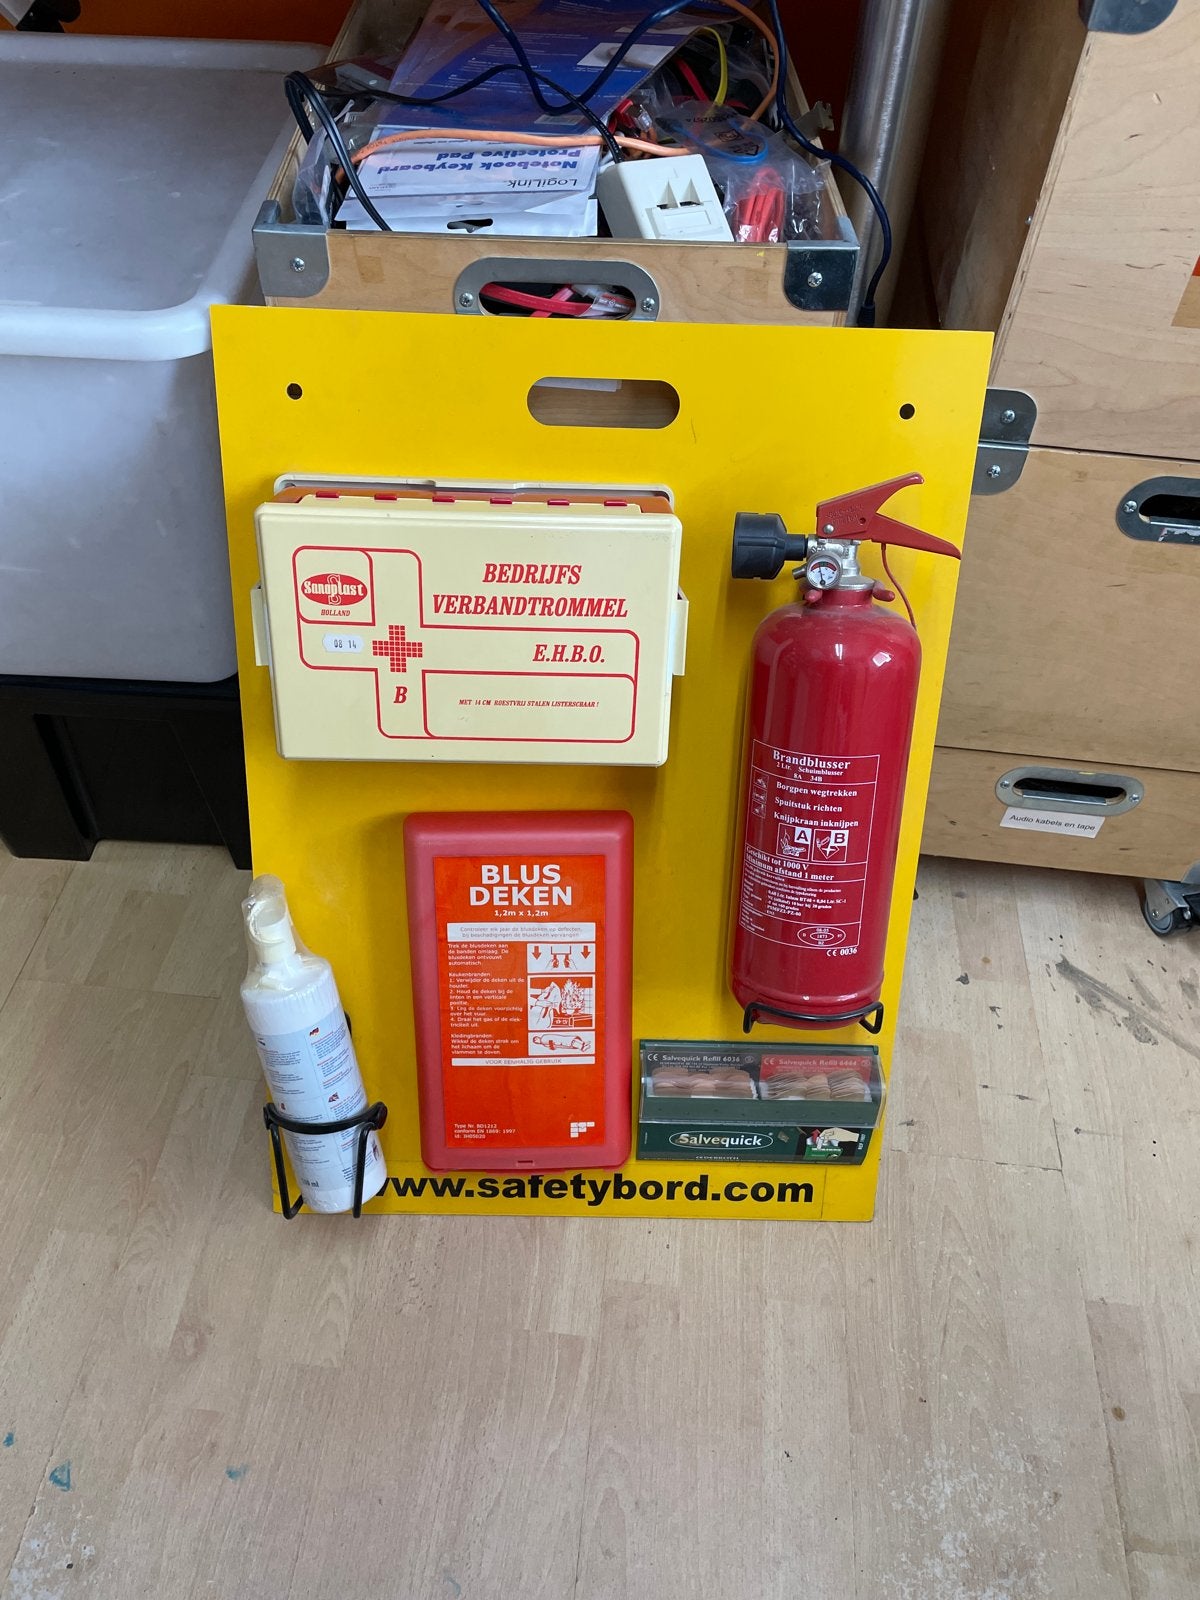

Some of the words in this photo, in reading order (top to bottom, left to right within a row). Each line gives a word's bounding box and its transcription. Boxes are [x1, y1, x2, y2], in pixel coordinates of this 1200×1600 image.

[436, 151, 474, 161] Pad
[481, 149, 580, 158] Protective
[377, 161, 472, 175] Keyboard
[481, 160, 578, 170] Notebook
[507, 178, 578, 189] LogiLink
[482, 563, 582, 585] BEDRIJFS
[320, 609, 351, 617] HOLLAND
[432, 594, 629, 618] VERBANDTROMMEL
[333, 639, 343, 649] 08
[348, 639, 357, 649] 14
[532, 644, 606, 663] E.H.B.O.
[393, 685, 408, 704] B
[773, 750, 851, 770] Brandblusser
[798, 766, 844, 777] Schuimblusser
[776, 782, 809, 795] Borgpen
[810, 788, 858, 798] wegtrekken
[775, 797, 811, 810] Spuitstuk
[812, 804, 843, 813] richten
[773, 811, 819, 827] Knijpkraan
[820, 819, 859, 829] inknijpen
[1008, 814, 1034, 823] Audio
[1035, 816, 1062, 828] kabels
[1064, 820, 1075, 828] en
[1077, 822, 1096, 832] tape
[796, 829, 809, 842] A
[834, 832, 846, 844] B
[745, 853, 773, 872] Minimum
[774, 866, 802, 878] afstand
[782, 860, 801, 870] 1000
[481, 864, 561, 884] BLUS
[469, 885, 573, 906] DEKEN
[494, 909, 516, 917] 1,2m
[527, 909, 549, 917] 1,2m
[839, 947, 858, 956] 0036
[662, 1054, 700, 1062] Salvequick
[678, 1132, 763, 1148] Salvequick
[376, 1172, 814, 1207] ww.safetybord.com
